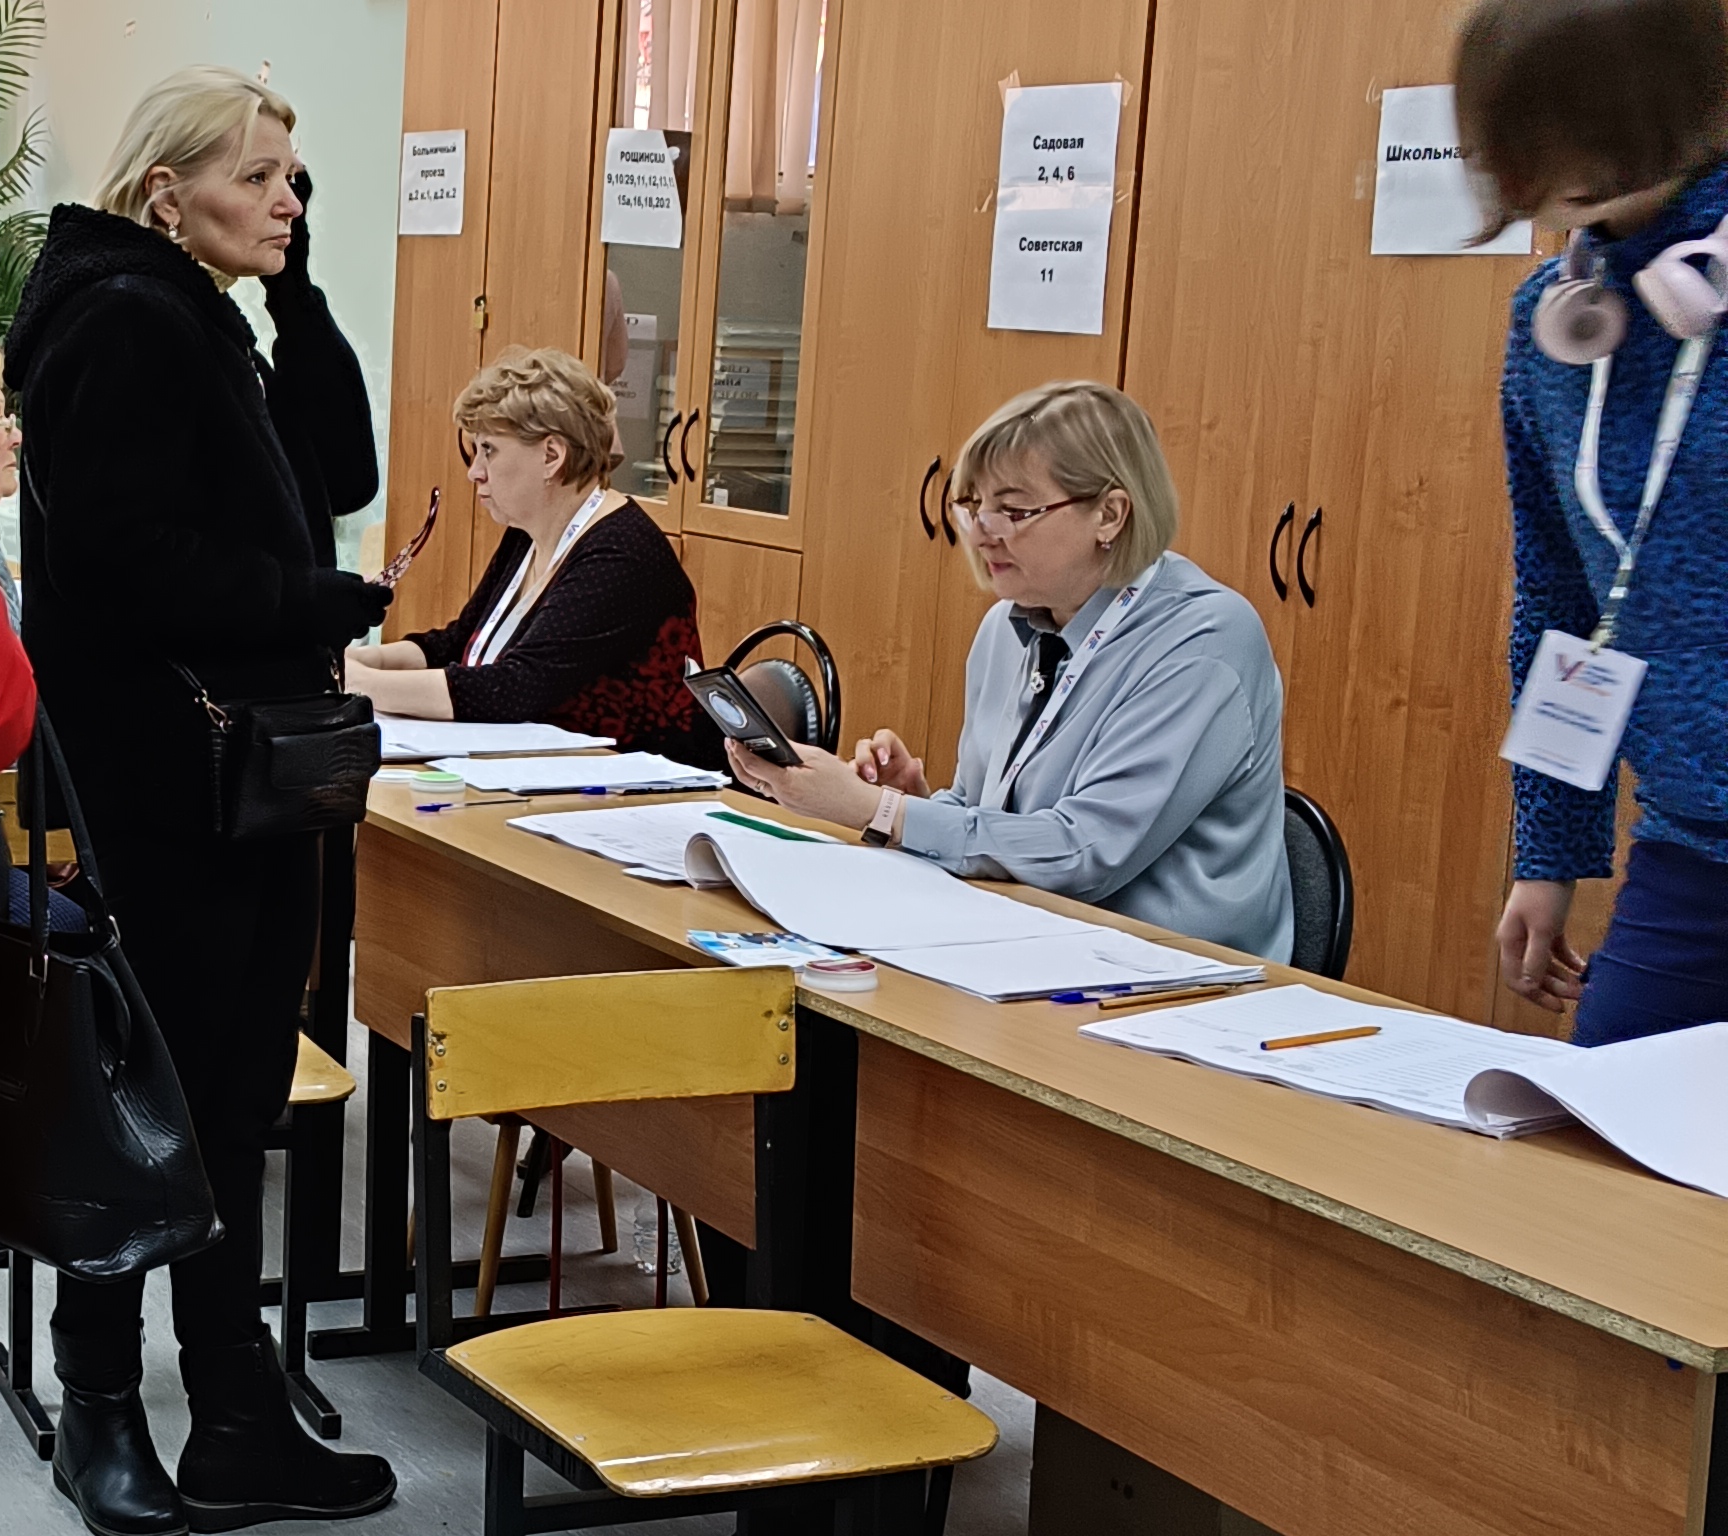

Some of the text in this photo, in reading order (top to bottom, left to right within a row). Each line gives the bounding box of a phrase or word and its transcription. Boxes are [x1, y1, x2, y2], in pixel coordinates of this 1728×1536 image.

[413, 143, 456, 156] Больничный
[1033, 135, 1084, 151] Садовая
[1386, 144, 1468, 162] Школьна
[420, 168, 445, 180] проезд
[1067, 166, 1075, 181] 6
[1019, 237, 1083, 253] Советская
[1040, 268, 1054, 283] 11
